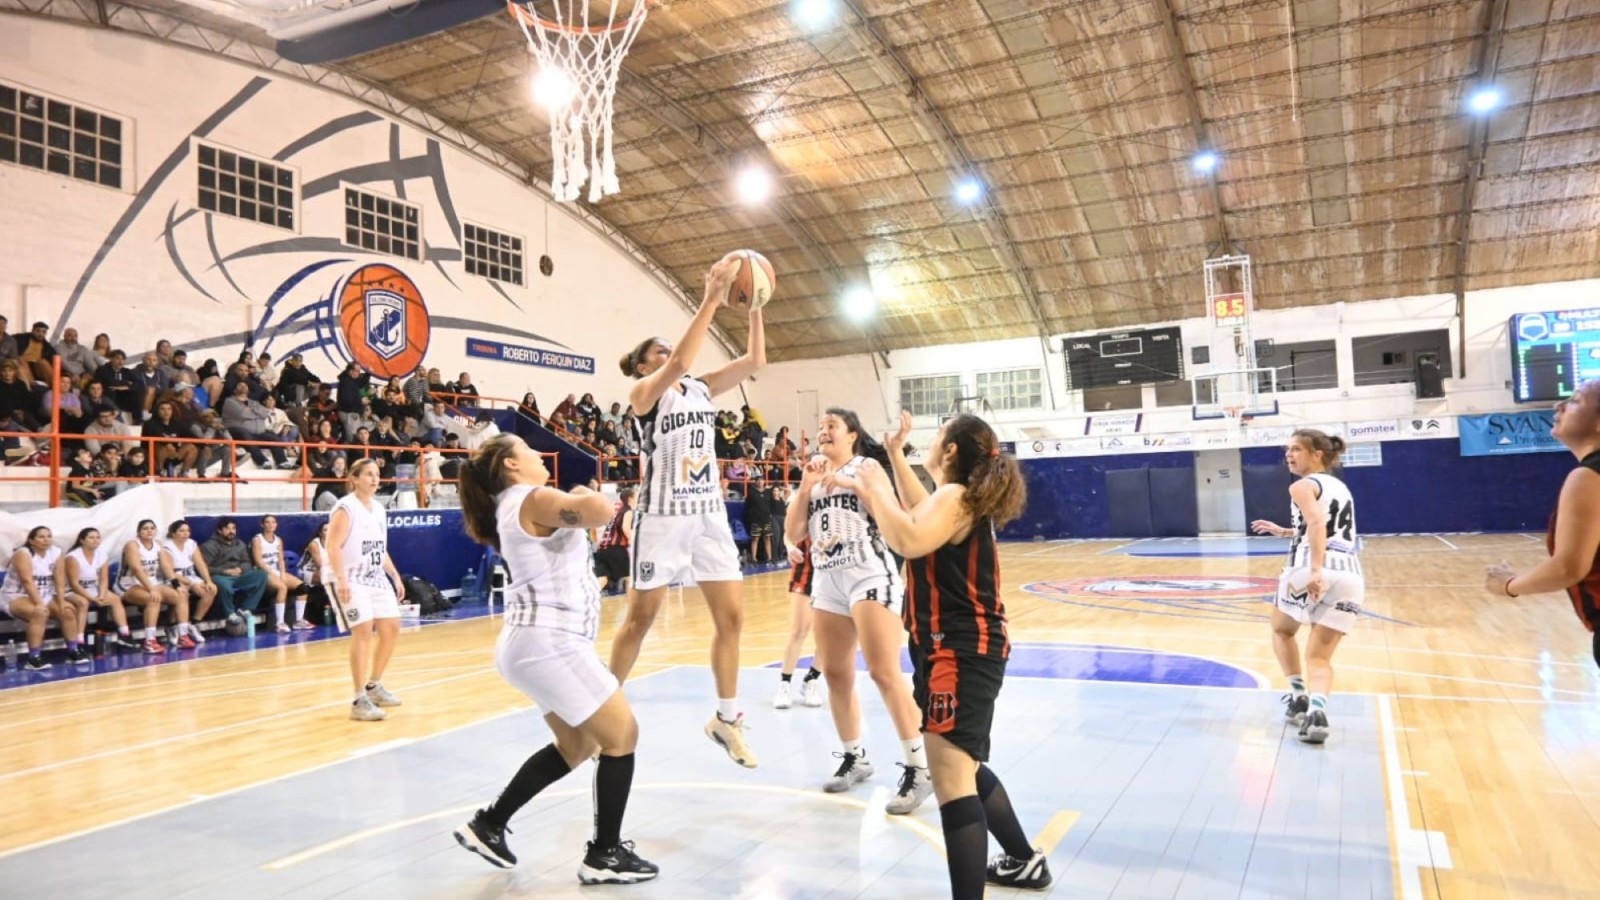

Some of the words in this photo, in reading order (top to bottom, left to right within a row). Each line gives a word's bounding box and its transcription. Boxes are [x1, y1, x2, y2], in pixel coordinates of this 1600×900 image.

[1215, 298, 1244, 318] 8.5
[502, 345, 540, 363] ROBERTO
[541, 353, 573, 368] PERIQUIN
[573, 358, 592, 371] DIAZ
[689, 428, 704, 449] 10
[1350, 425, 1395, 437] gomatex
[808, 493, 858, 519] GANTES
[387, 514, 441, 528] LOCALES
[821, 512, 829, 531] 8
[1327, 497, 1353, 542] 14
[370, 551, 381, 566] 13
